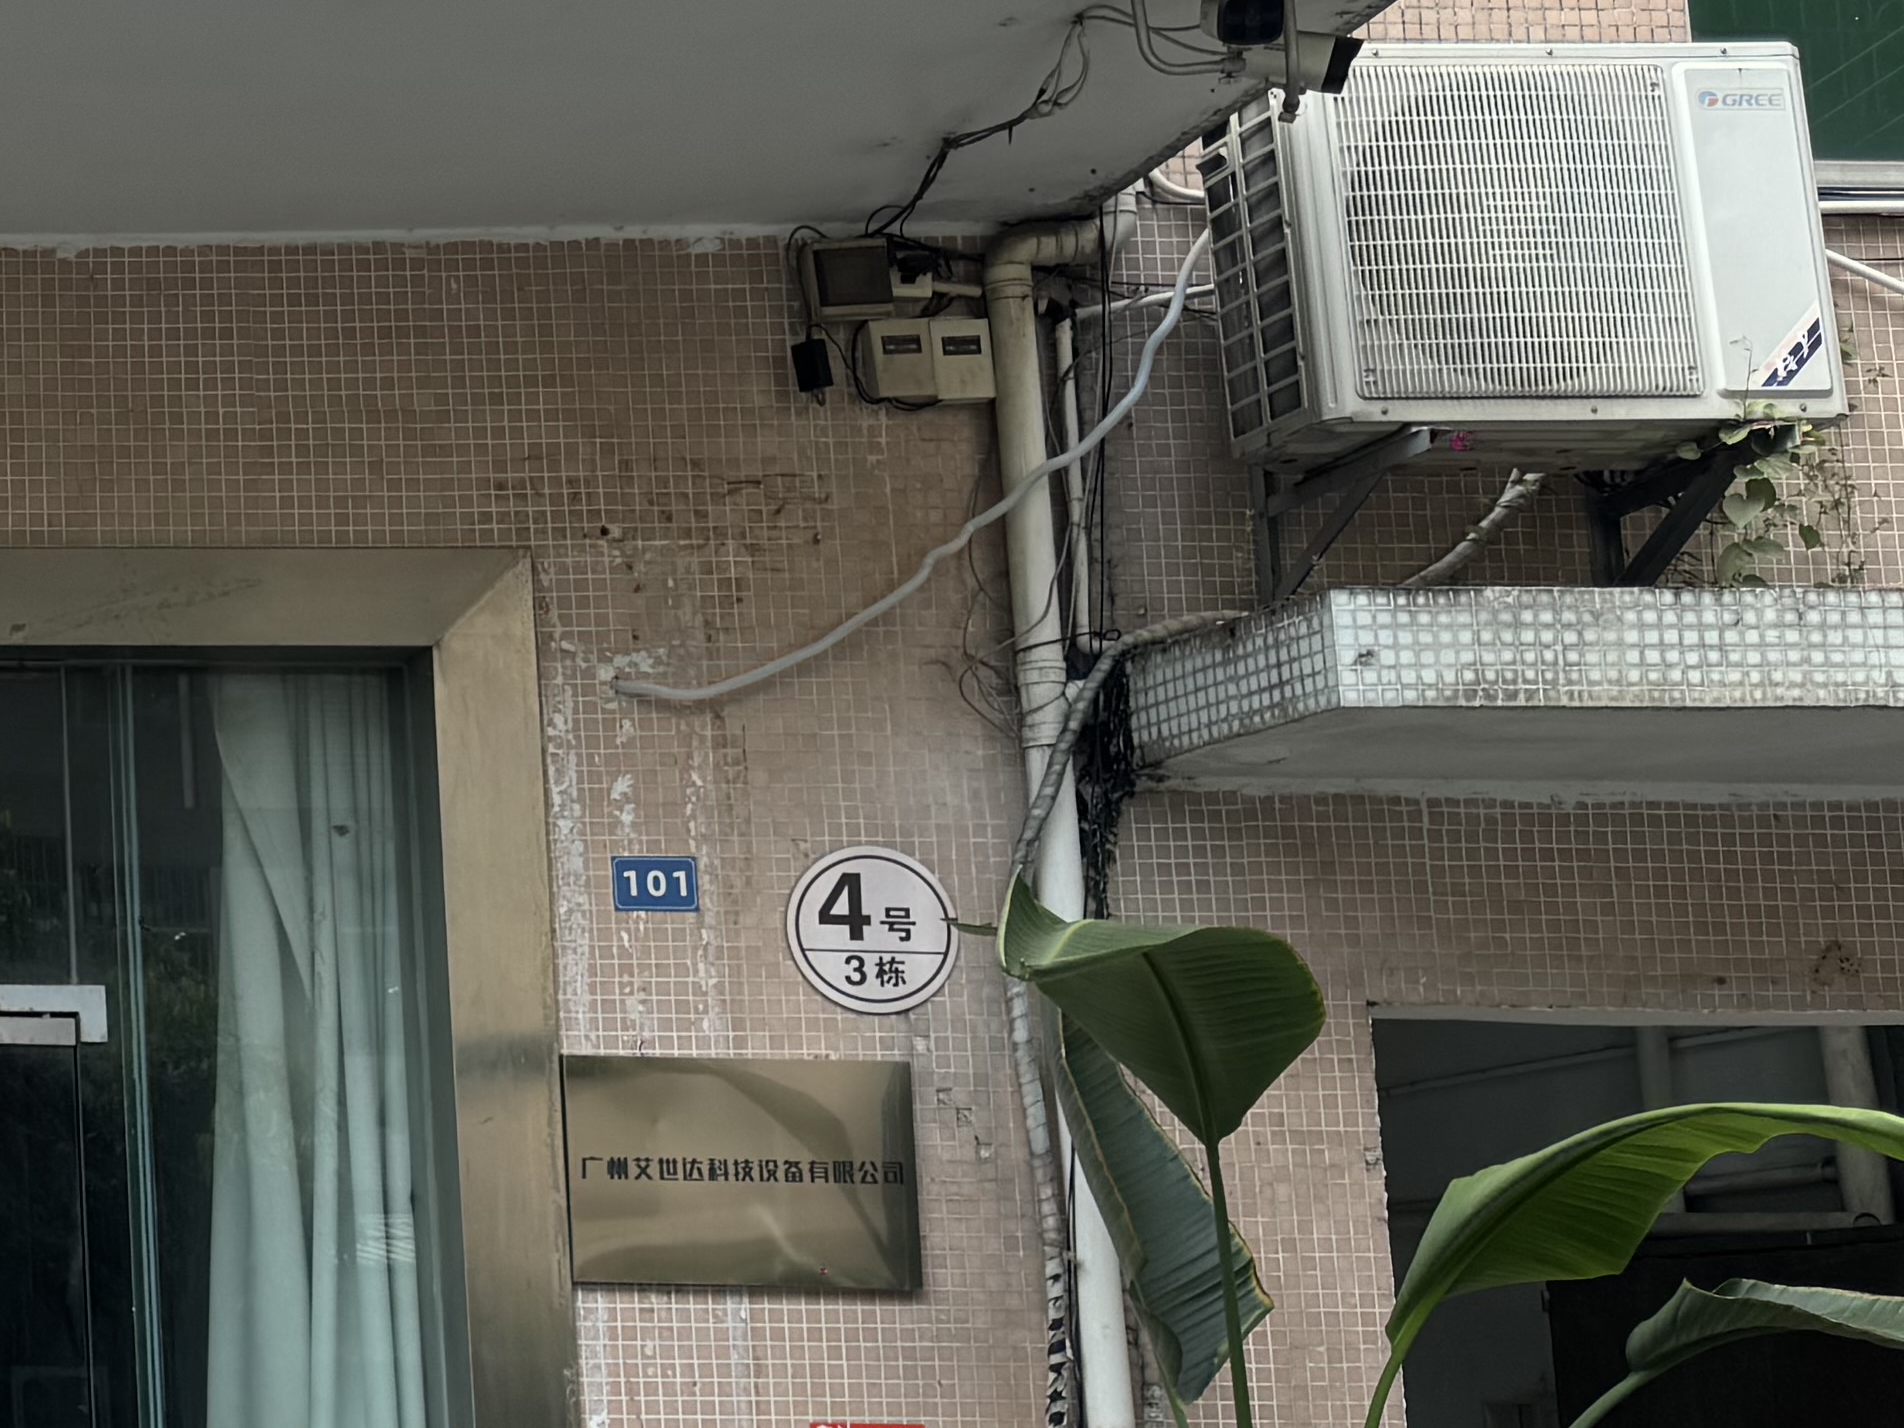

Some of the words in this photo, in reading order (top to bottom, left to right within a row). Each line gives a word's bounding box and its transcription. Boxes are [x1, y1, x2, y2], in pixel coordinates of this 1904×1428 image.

[1721, 93, 1784, 108] GREE
[622, 869, 689, 898] 101
[817, 871, 917, 943] 4号
[843, 954, 907, 988] 3栋
[580, 1155, 905, 1187] 广州艾世达科技设备有限公司
